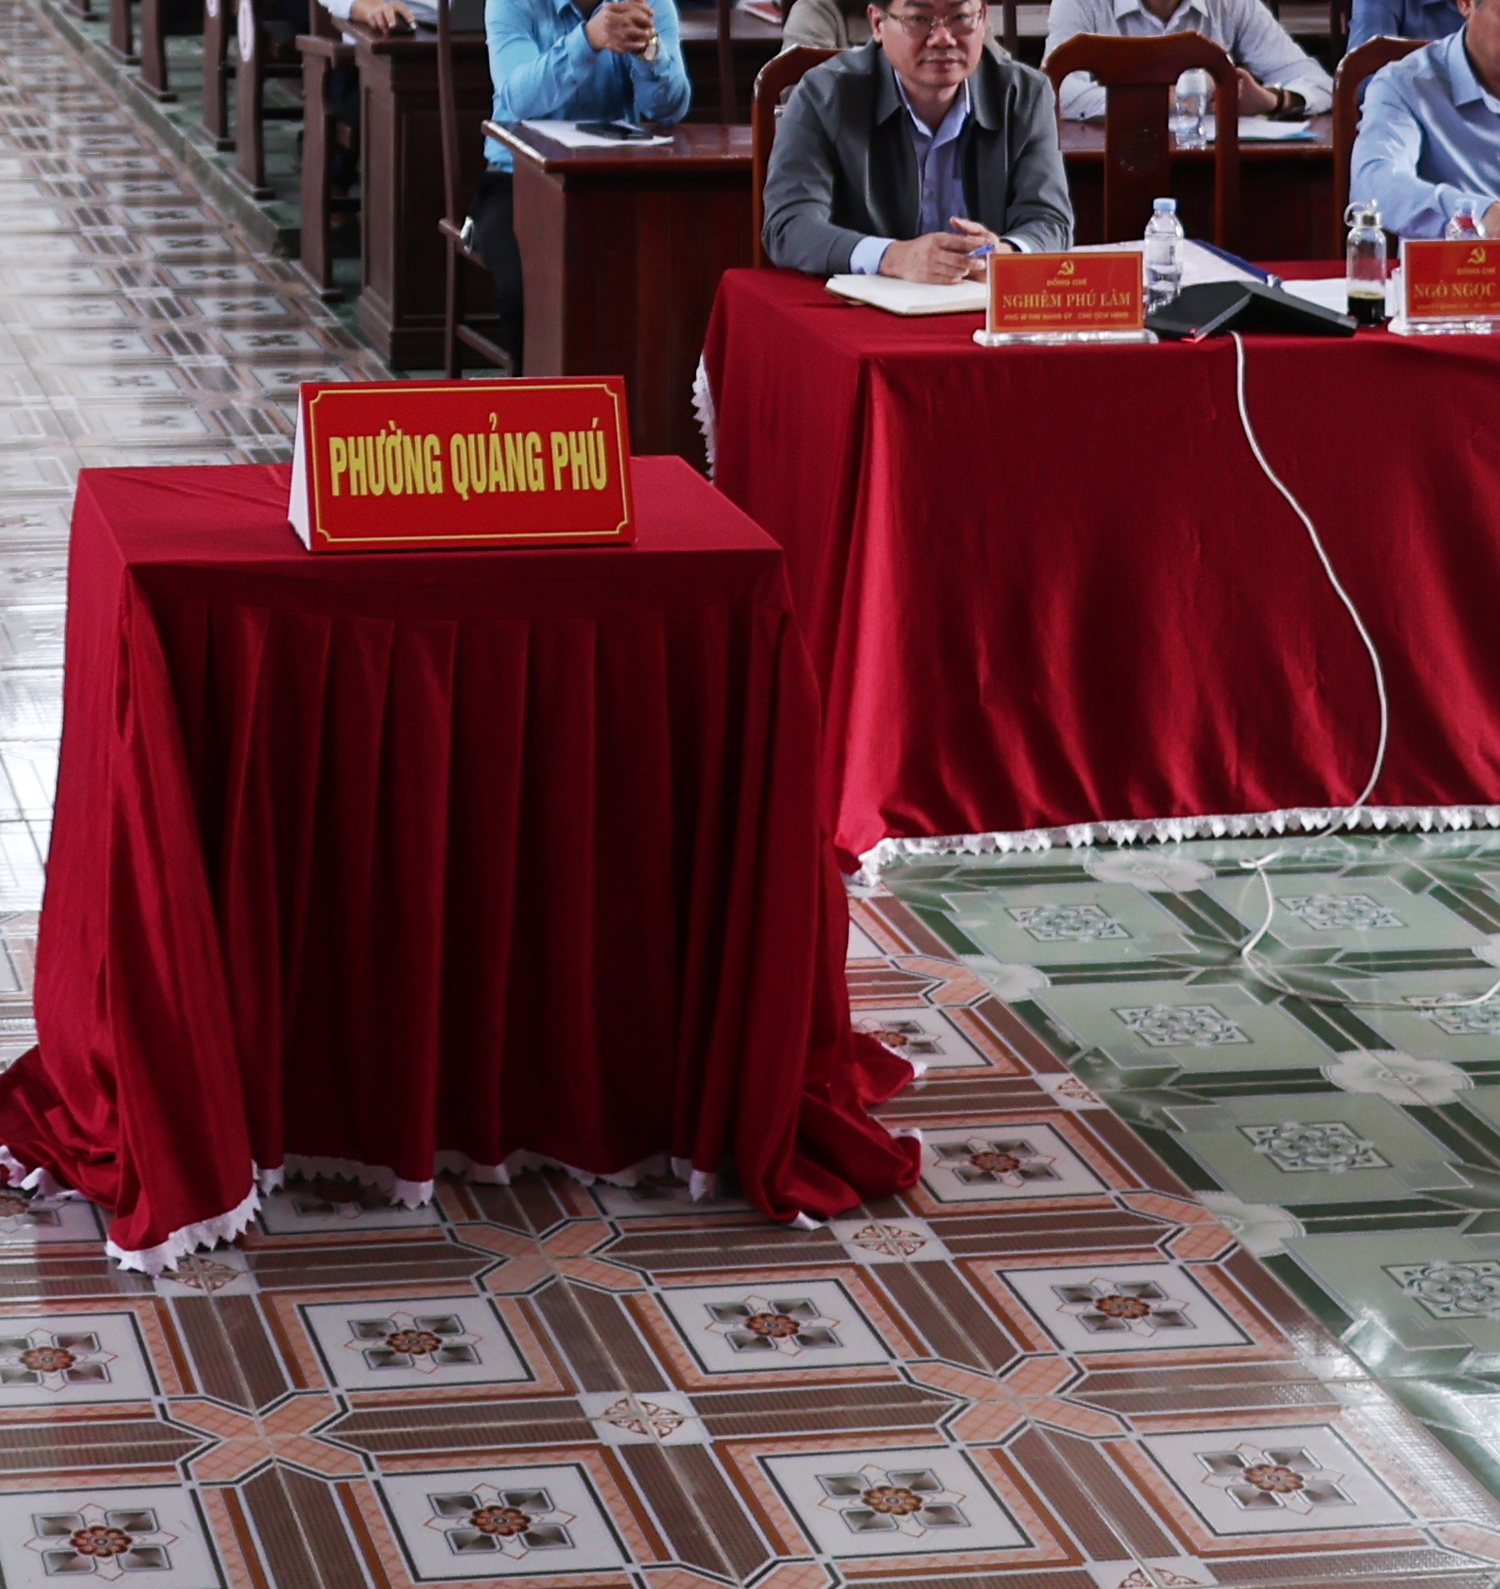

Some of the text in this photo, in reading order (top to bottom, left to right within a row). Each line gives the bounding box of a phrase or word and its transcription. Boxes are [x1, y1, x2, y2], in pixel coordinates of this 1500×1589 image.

[1002, 288, 1131, 308] NGHIÊM PHÚ LÂM
[1452, 281, 1496, 300] NGỌC
[330, 412, 608, 501] PHƯỜNG QUẢNG PHÚ
